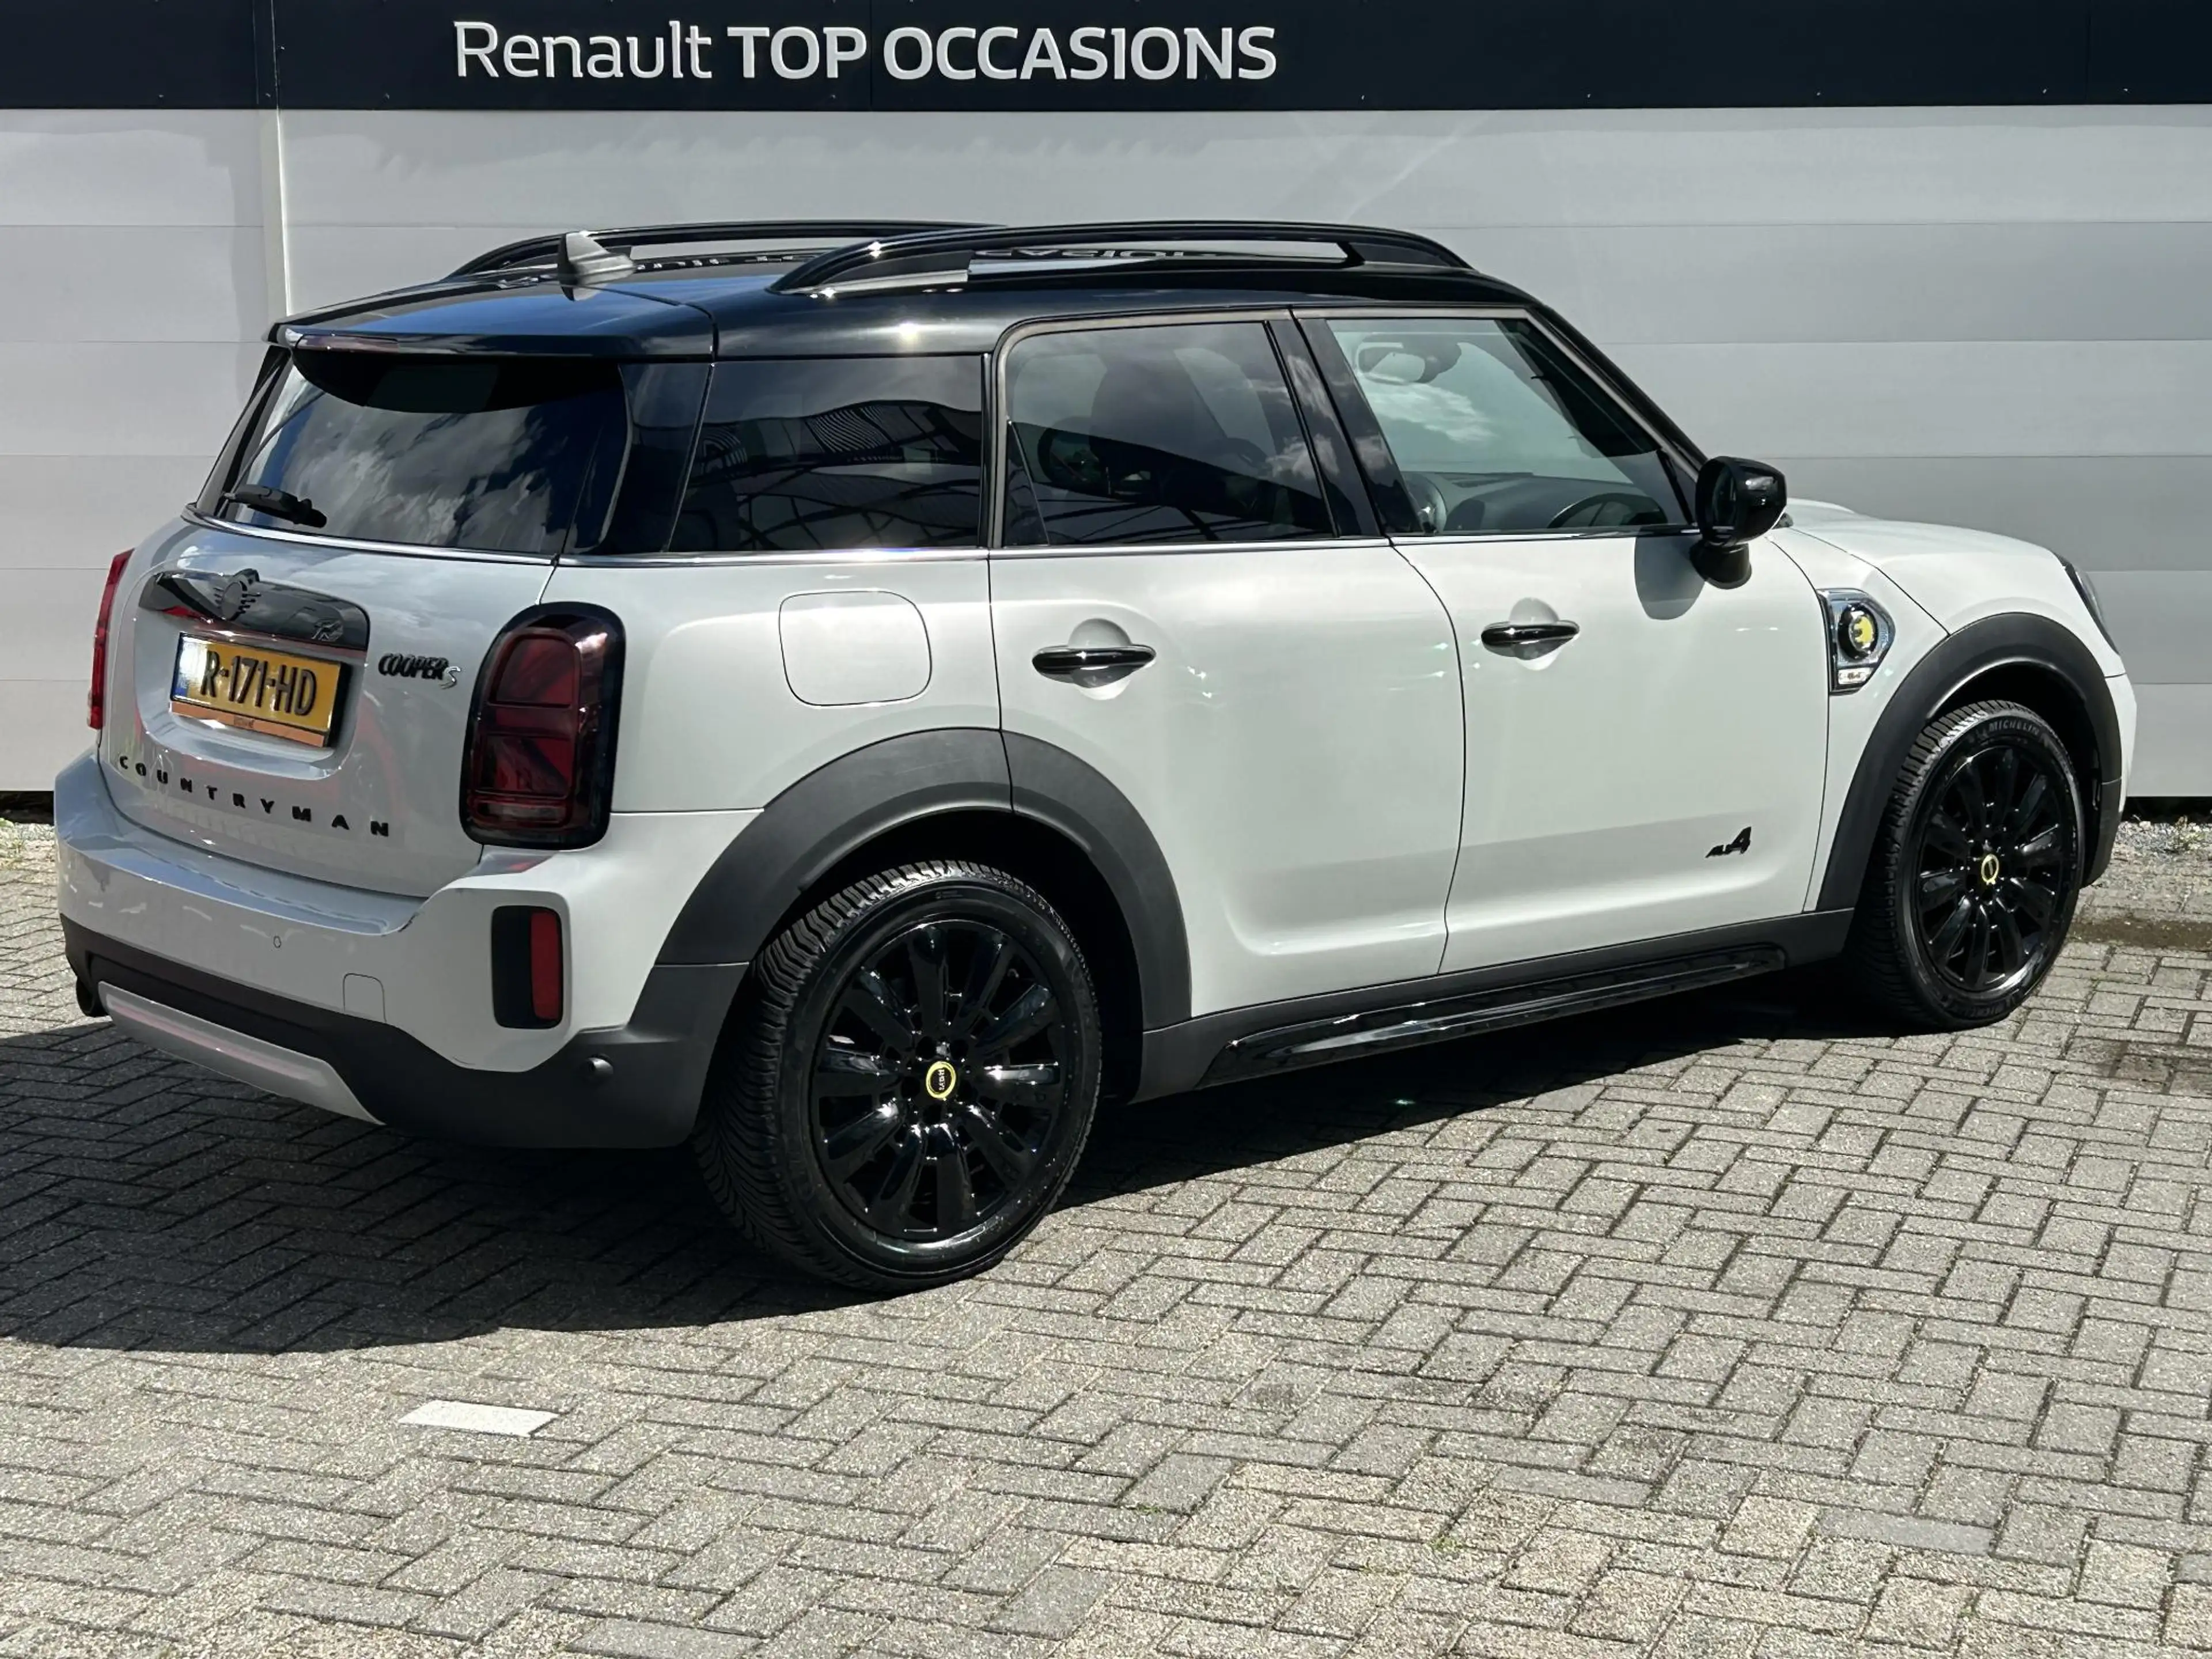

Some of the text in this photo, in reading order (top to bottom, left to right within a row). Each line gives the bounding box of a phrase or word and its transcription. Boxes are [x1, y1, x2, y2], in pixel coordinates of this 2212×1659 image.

[453, 20, 1277, 79] Renault TOP OCCASIONS
[200, 650, 317, 716] R-171-HD
[119, 756, 389, 838] COUNTRYMAN
